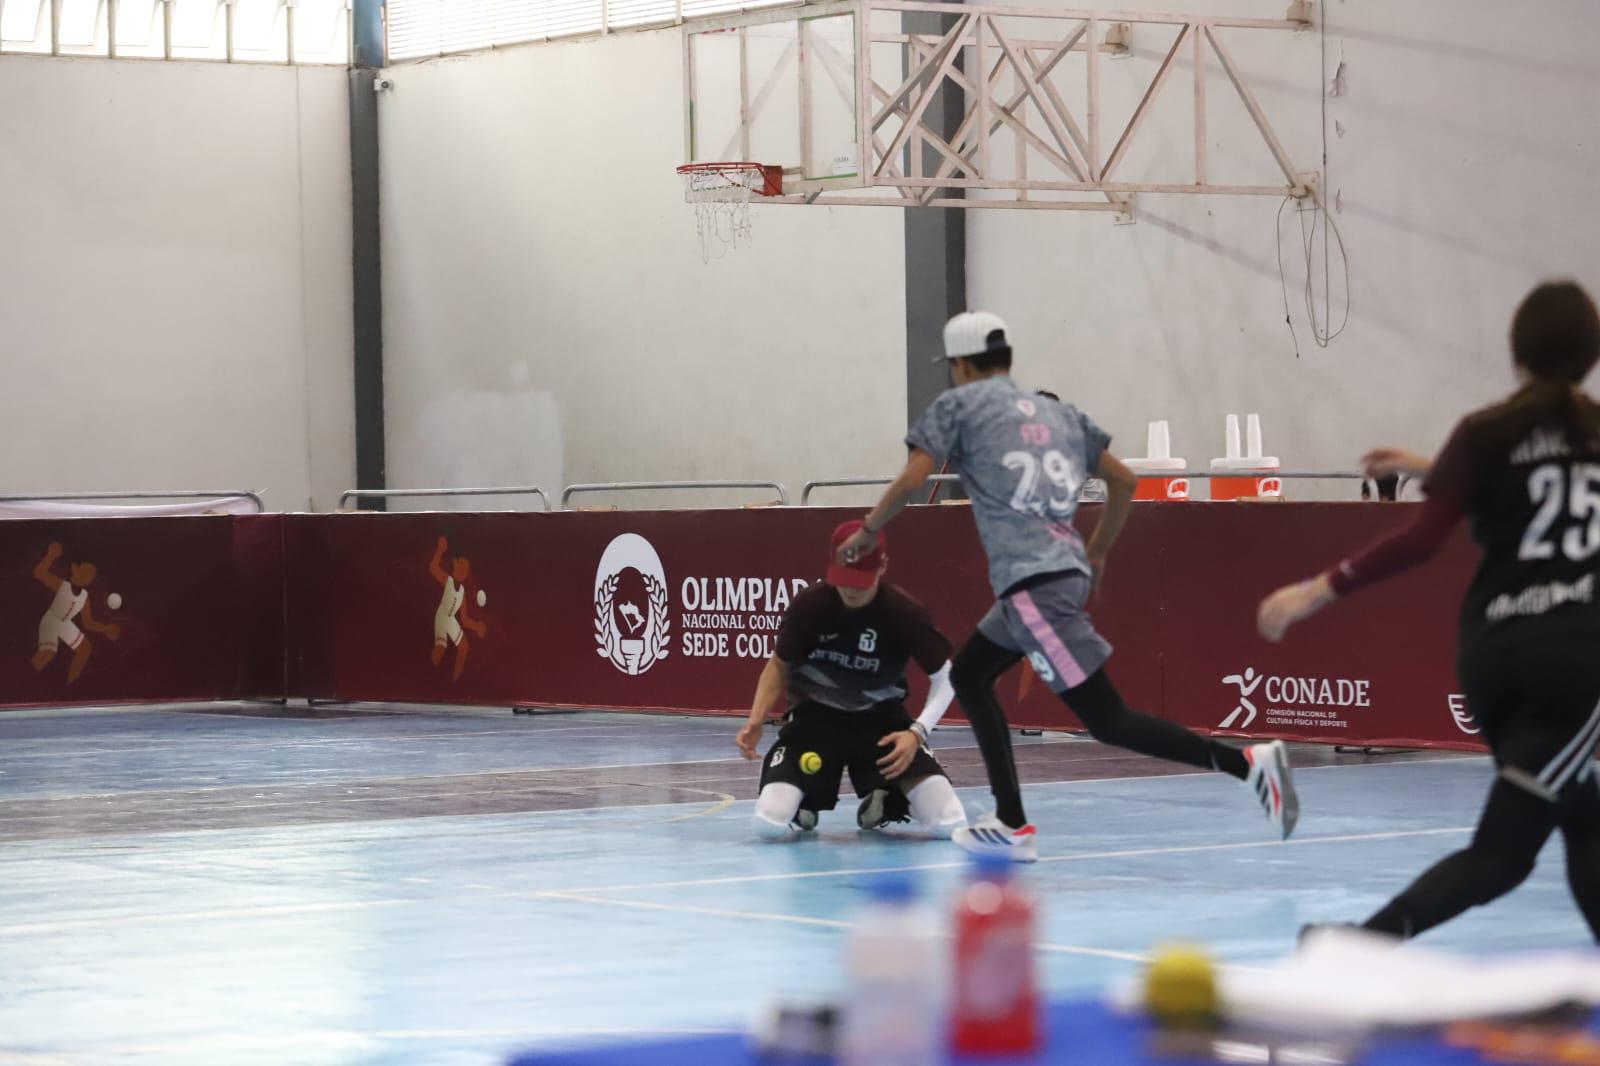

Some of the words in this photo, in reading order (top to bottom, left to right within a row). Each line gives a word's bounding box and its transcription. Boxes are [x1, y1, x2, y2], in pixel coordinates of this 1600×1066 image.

[1002, 450, 1075, 515] 29
[1517, 463, 1600, 561] 25
[682, 613, 745, 629] NACIONAL
[682, 632, 729, 657] SEDE
[735, 633, 779, 659] COL
[1265, 676, 1370, 707] CONADE
[1266, 708, 1295, 716] COMISIÓN
[1296, 710, 1327, 718] NACIONAL
[1266, 717, 1293, 725] CULTURA
[1319, 719, 1348, 728] DEPORTE
